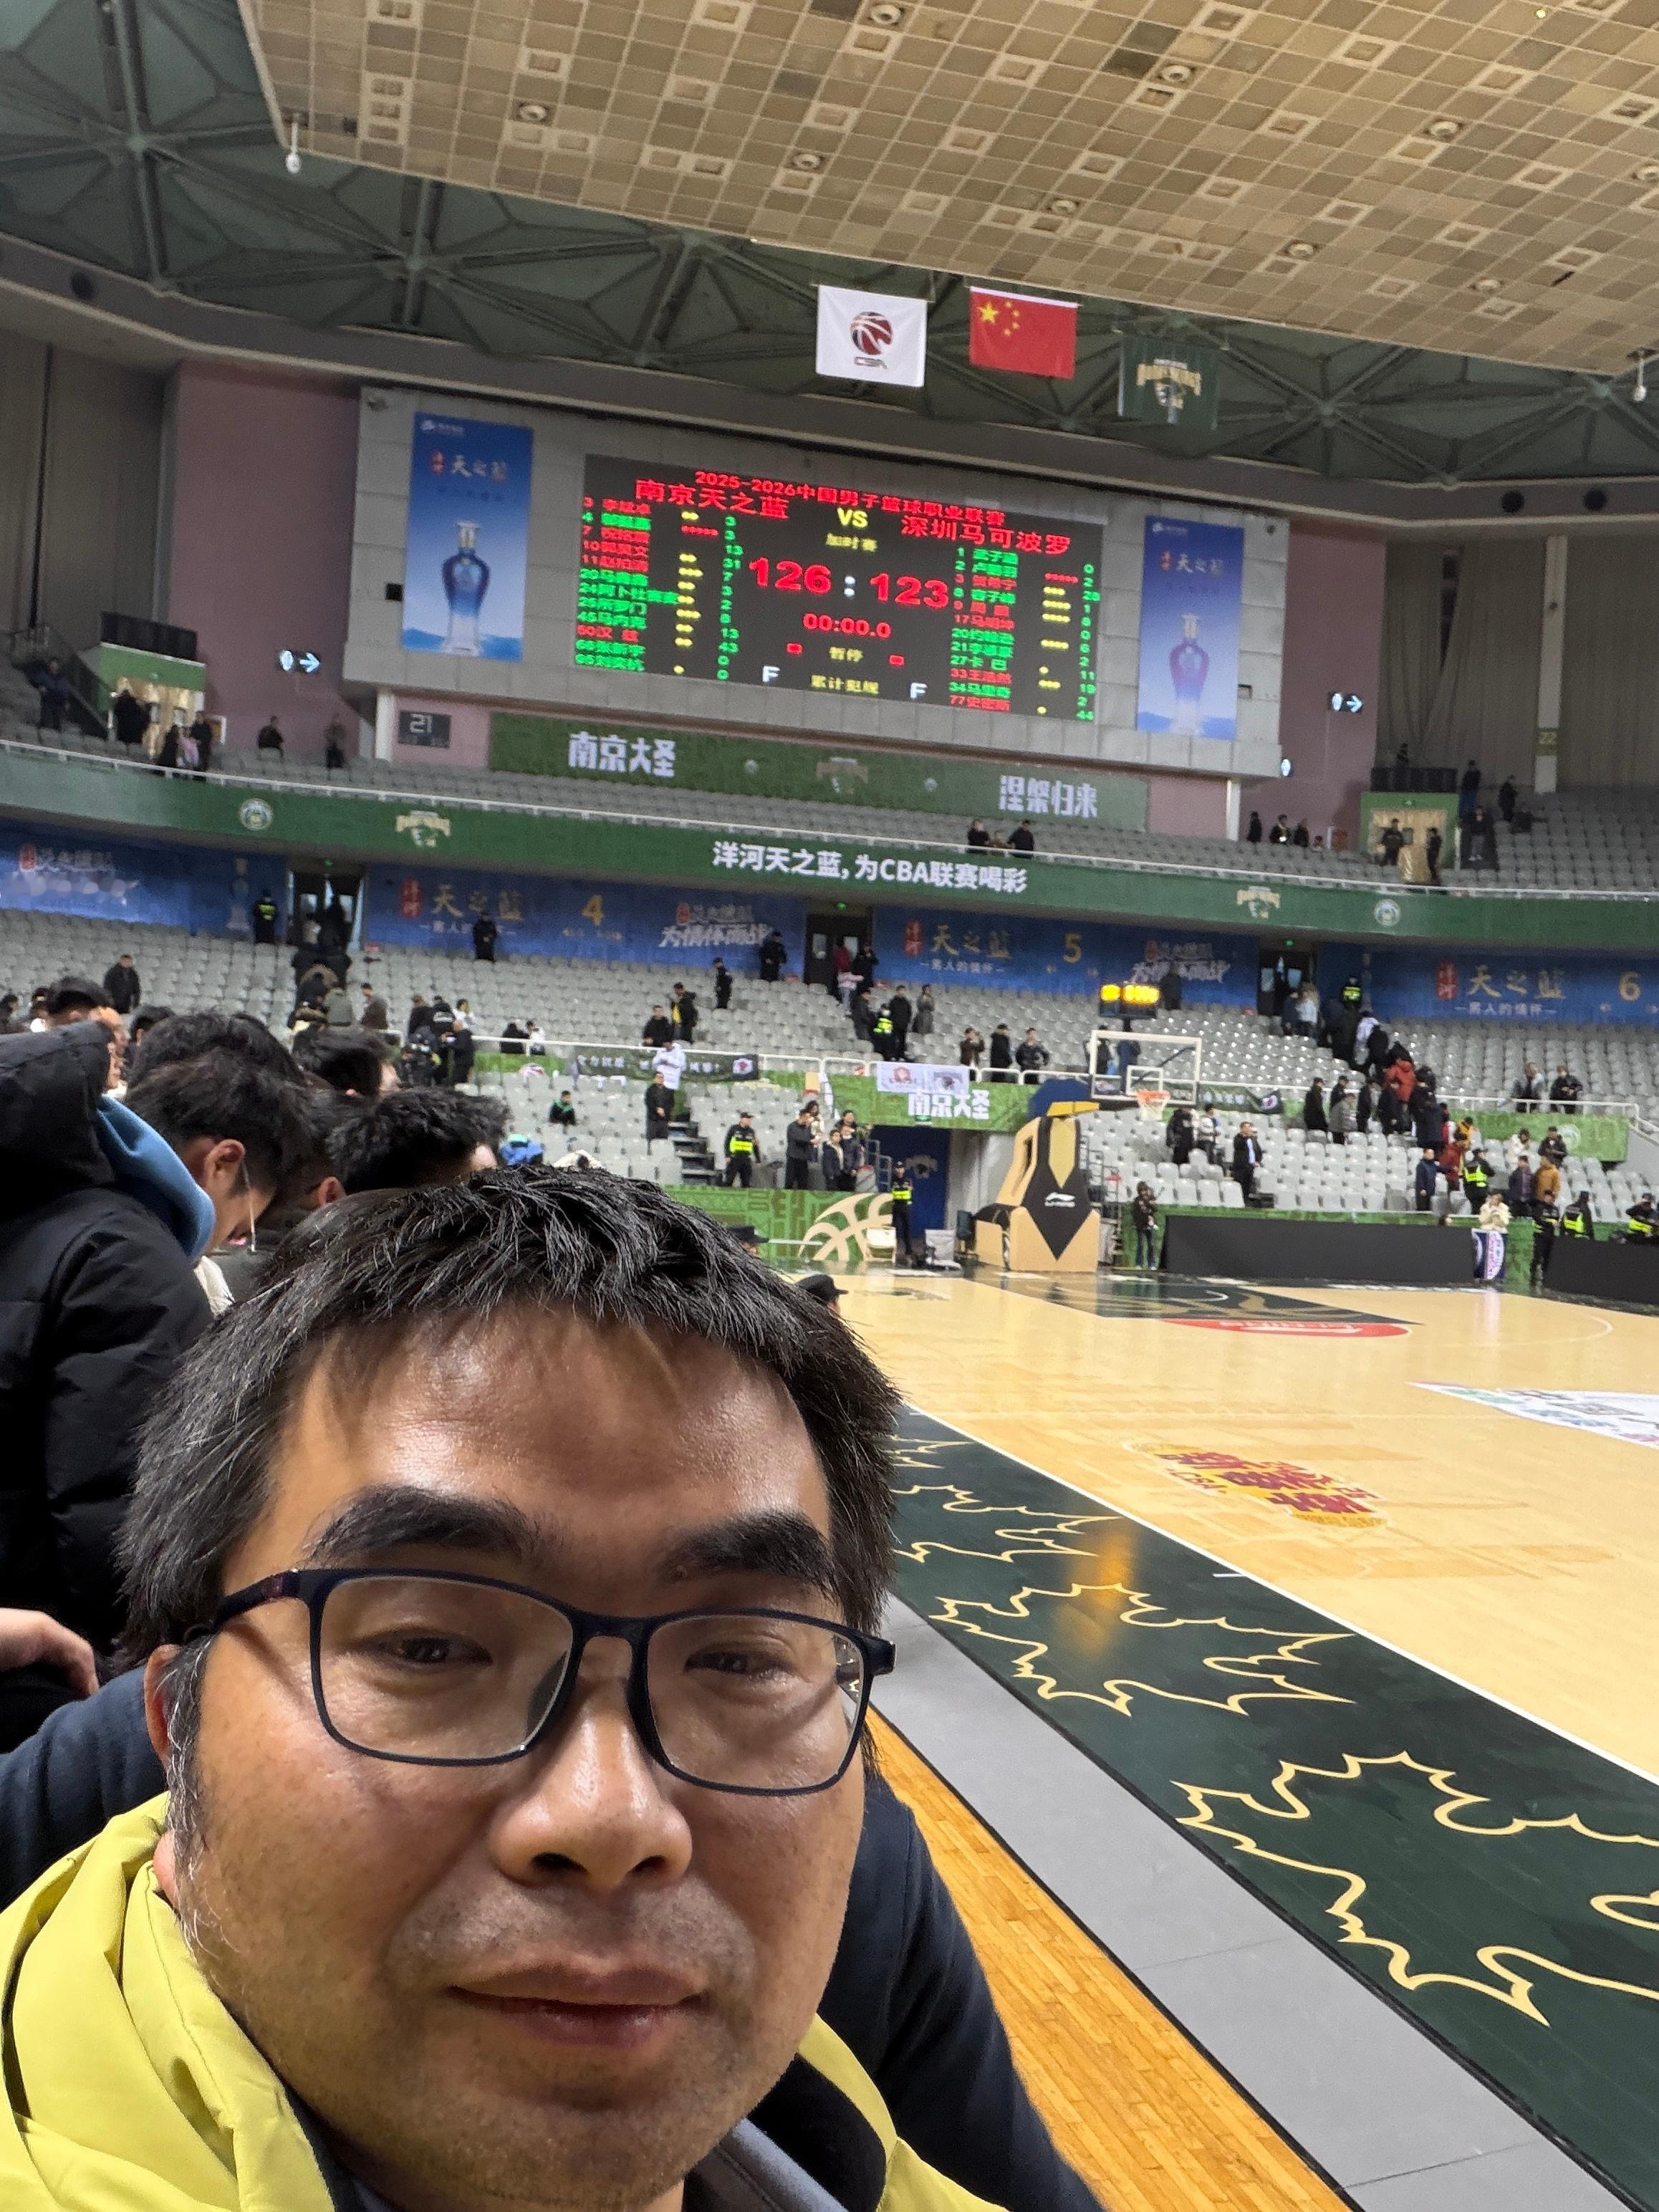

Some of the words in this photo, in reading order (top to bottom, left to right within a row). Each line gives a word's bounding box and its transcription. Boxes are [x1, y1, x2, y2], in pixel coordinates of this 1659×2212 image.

[635, 479, 789, 519] 南京天之蓝
[837, 507, 868, 528] VS
[901, 514, 1071, 555] 深圳马可波罗
[748, 557, 832, 594] 126
[870, 572, 949, 608] 123
[803, 612, 892, 639] 00:00.0
[762, 665, 780, 683] F
[910, 683, 928, 700] F
[568, 731, 676, 778] 南京大圣
[999, 775, 1097, 818] 涅槃归来
[580, 893, 605, 926] 4
[1063, 933, 1082, 963] 5
[1618, 971, 1641, 1001] 6
